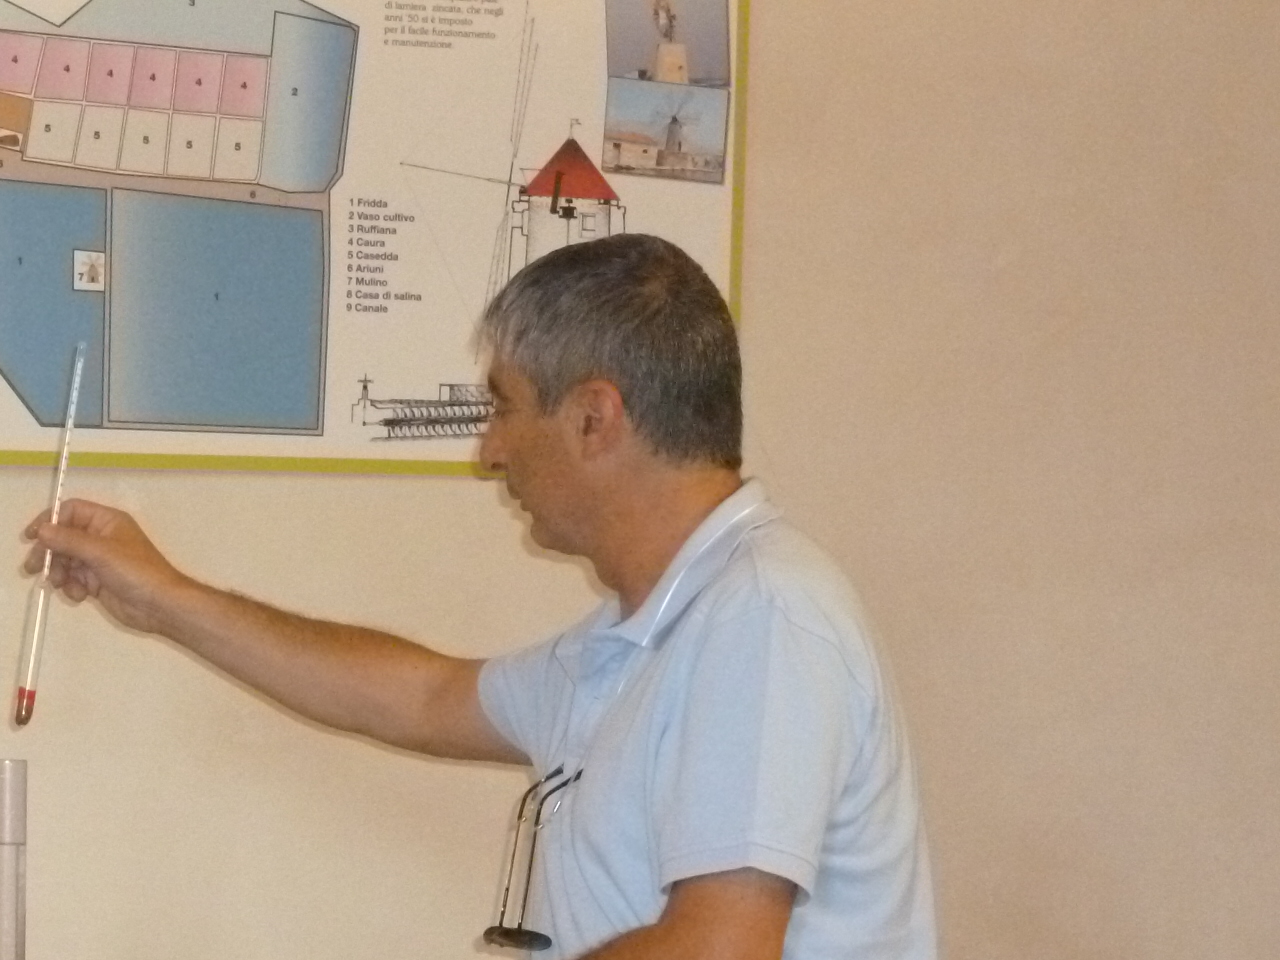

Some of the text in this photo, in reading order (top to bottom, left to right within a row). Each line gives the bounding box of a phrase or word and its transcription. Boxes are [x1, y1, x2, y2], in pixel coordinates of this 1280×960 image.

[12, 55, 18, 64] 4
[64, 65, 70, 73] 4
[107, 69, 113, 78] 4
[150, 73, 156, 82] 4
[195, 78, 202, 86] 4
[241, 82, 248, 90] 4
[291, 87, 298, 96] 2
[44, 124, 51, 132] 5
[94, 131, 100, 140] 5
[143, 136, 149, 144] 5
[186, 141, 193, 149] 5
[235, 142, 241, 151] 5
[349, 198, 388, 208] 1 Fridda
[349, 211, 415, 222] 2 Vaso cultivo
[348, 225, 397, 235] 3 Ruffiana
[348, 238, 385, 247] 4 Caura
[347, 251, 399, 261] 5 Casedda
[347, 264, 384, 273] 6 Ariuni
[78, 273, 84, 281] 7
[347, 277, 388, 287] 7 Mulino
[346, 290, 422, 301] 8 Casa di salina
[346, 303, 388, 313] 9 Canale
